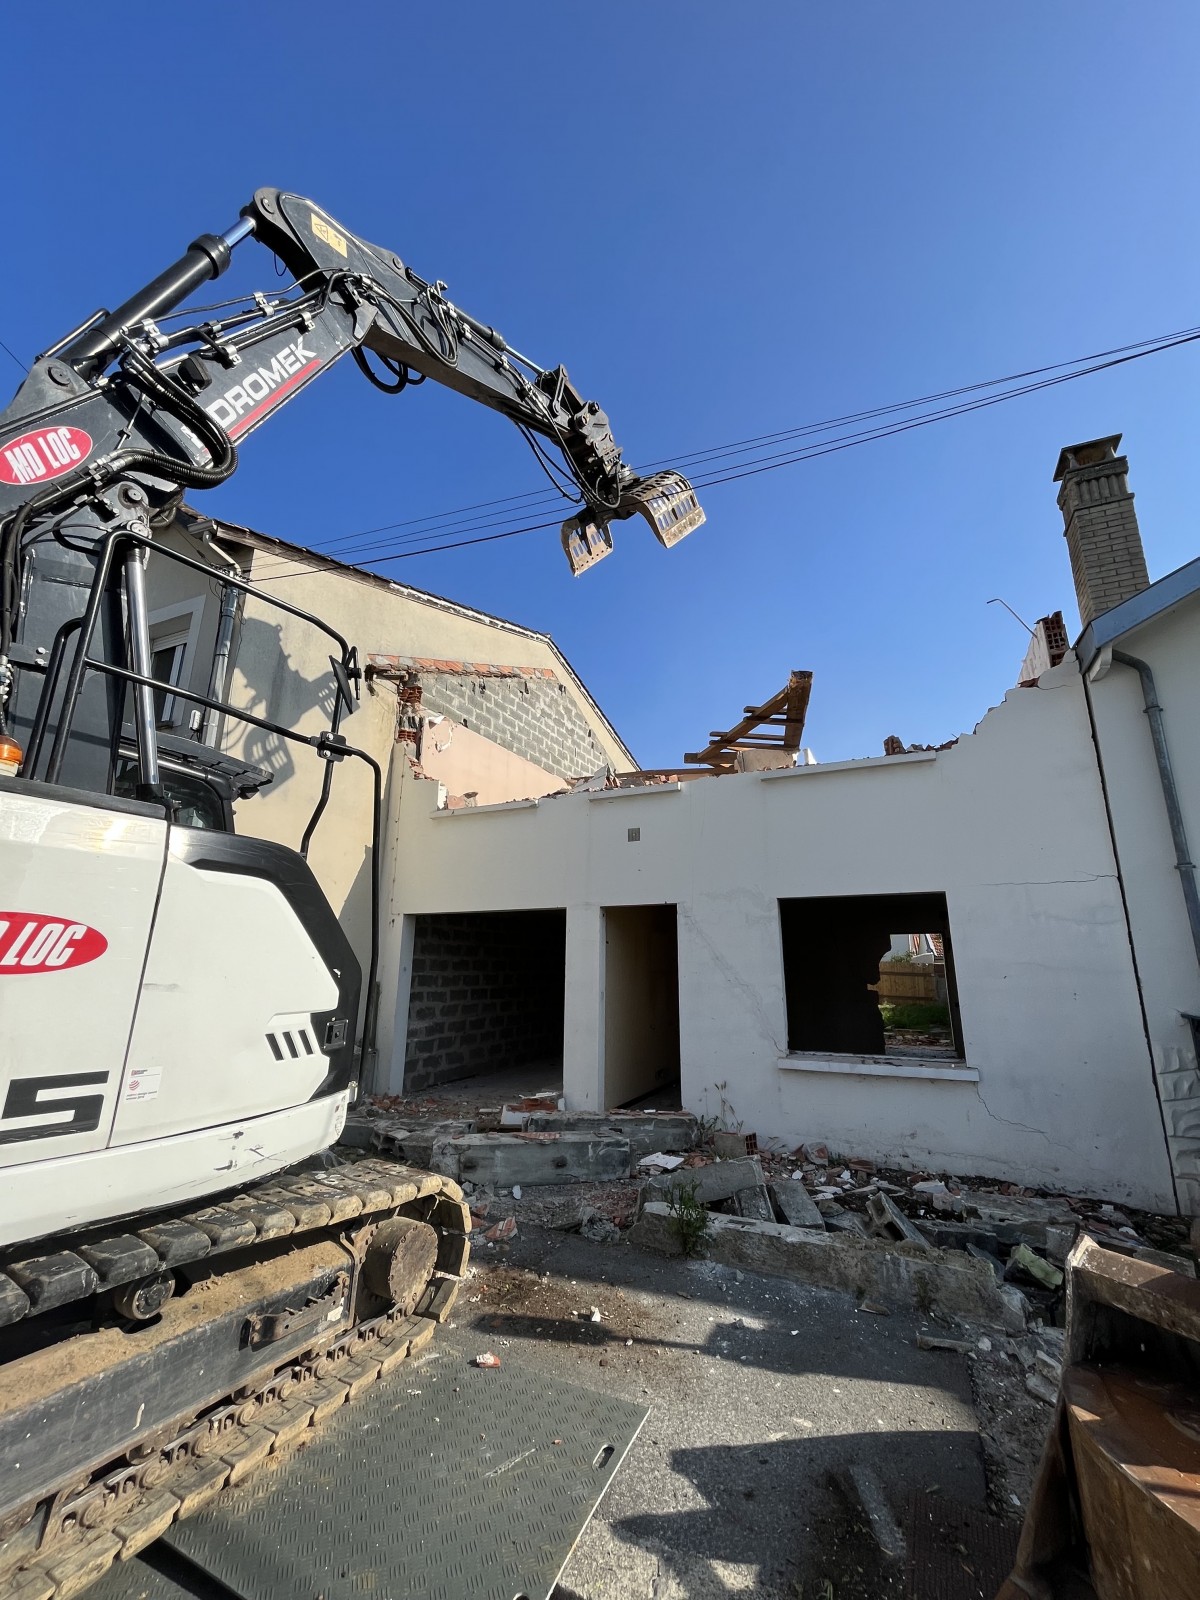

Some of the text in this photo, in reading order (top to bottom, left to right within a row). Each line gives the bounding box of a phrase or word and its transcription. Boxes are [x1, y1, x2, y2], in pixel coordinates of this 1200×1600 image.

[181, 336, 317, 449] DROMEK
[4, 427, 81, 484] MD LOC
[0, 921, 88, 966] LOC
